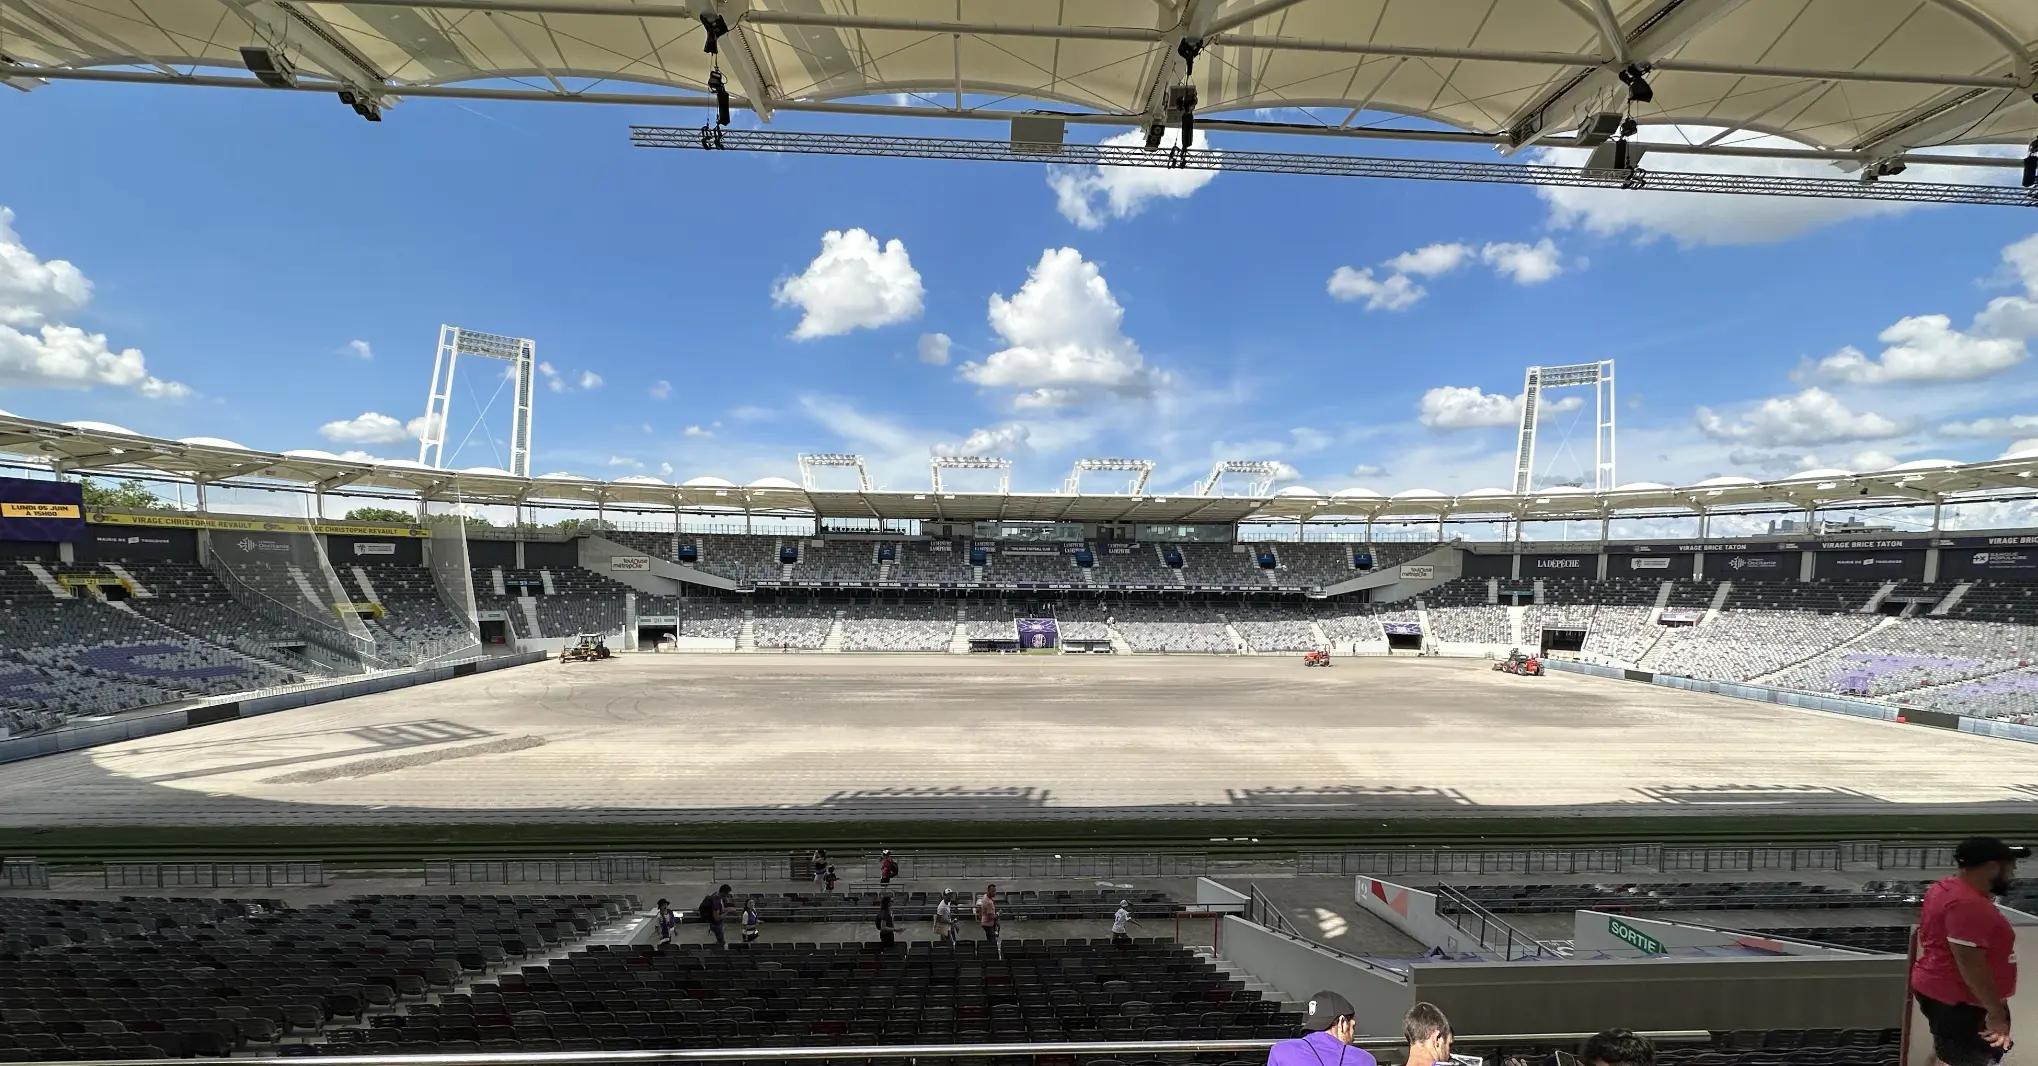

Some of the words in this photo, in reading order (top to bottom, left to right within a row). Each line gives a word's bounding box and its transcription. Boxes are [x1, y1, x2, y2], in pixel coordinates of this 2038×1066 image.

[132, 516, 164, 524] VIRAGE
[165, 517, 216, 527] CHRISTOPHE
[218, 520, 252, 529] REVAULT
[324, 525, 366, 534] CHRISTOPHE
[368, 527, 398, 535] REVAULT
[1822, 541, 1850, 549] VIRAGE
[1989, 537, 2019, 545] VIRAGE
[1611, 921, 1657, 953] SORTIE
